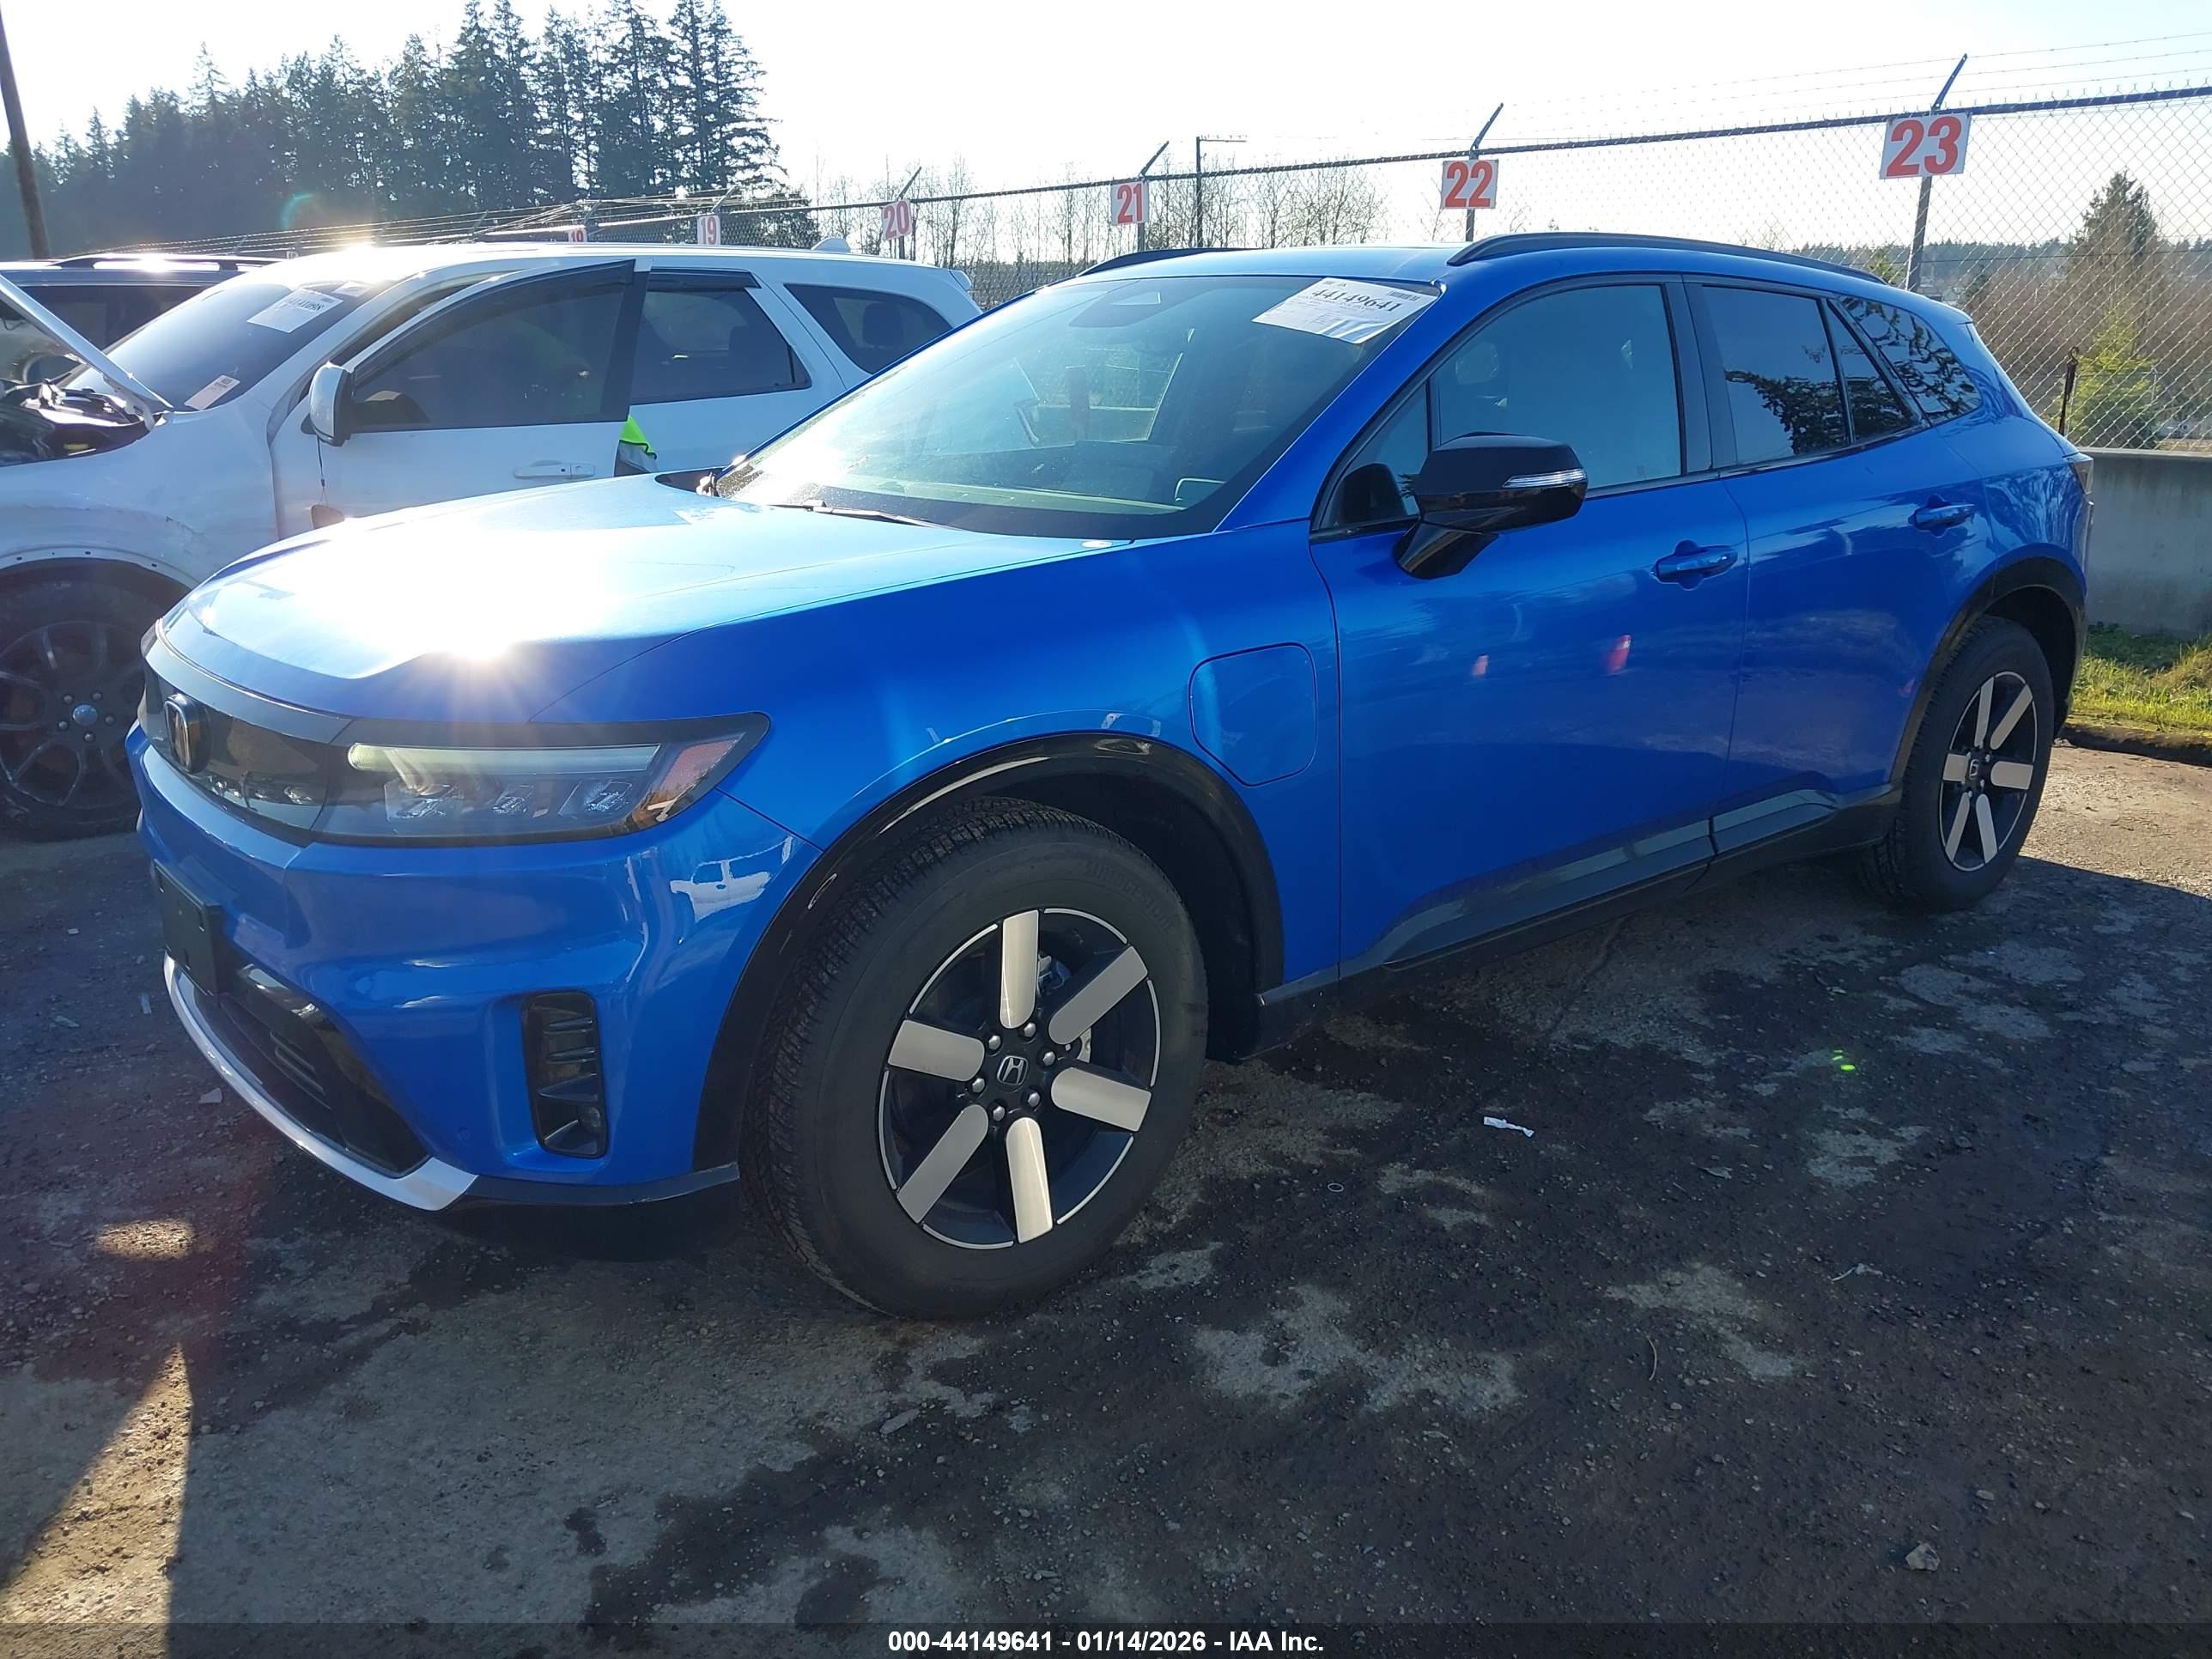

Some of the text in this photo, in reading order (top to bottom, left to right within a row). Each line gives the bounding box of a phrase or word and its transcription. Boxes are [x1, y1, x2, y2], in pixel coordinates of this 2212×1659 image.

[1886, 116, 1961, 177] 23
[1117, 183, 1143, 223] 21
[1445, 161, 1492, 207] 22
[701, 216, 717, 245] 19
[884, 201, 909, 240] 20
[1312, 289, 1402, 311] 44149641
